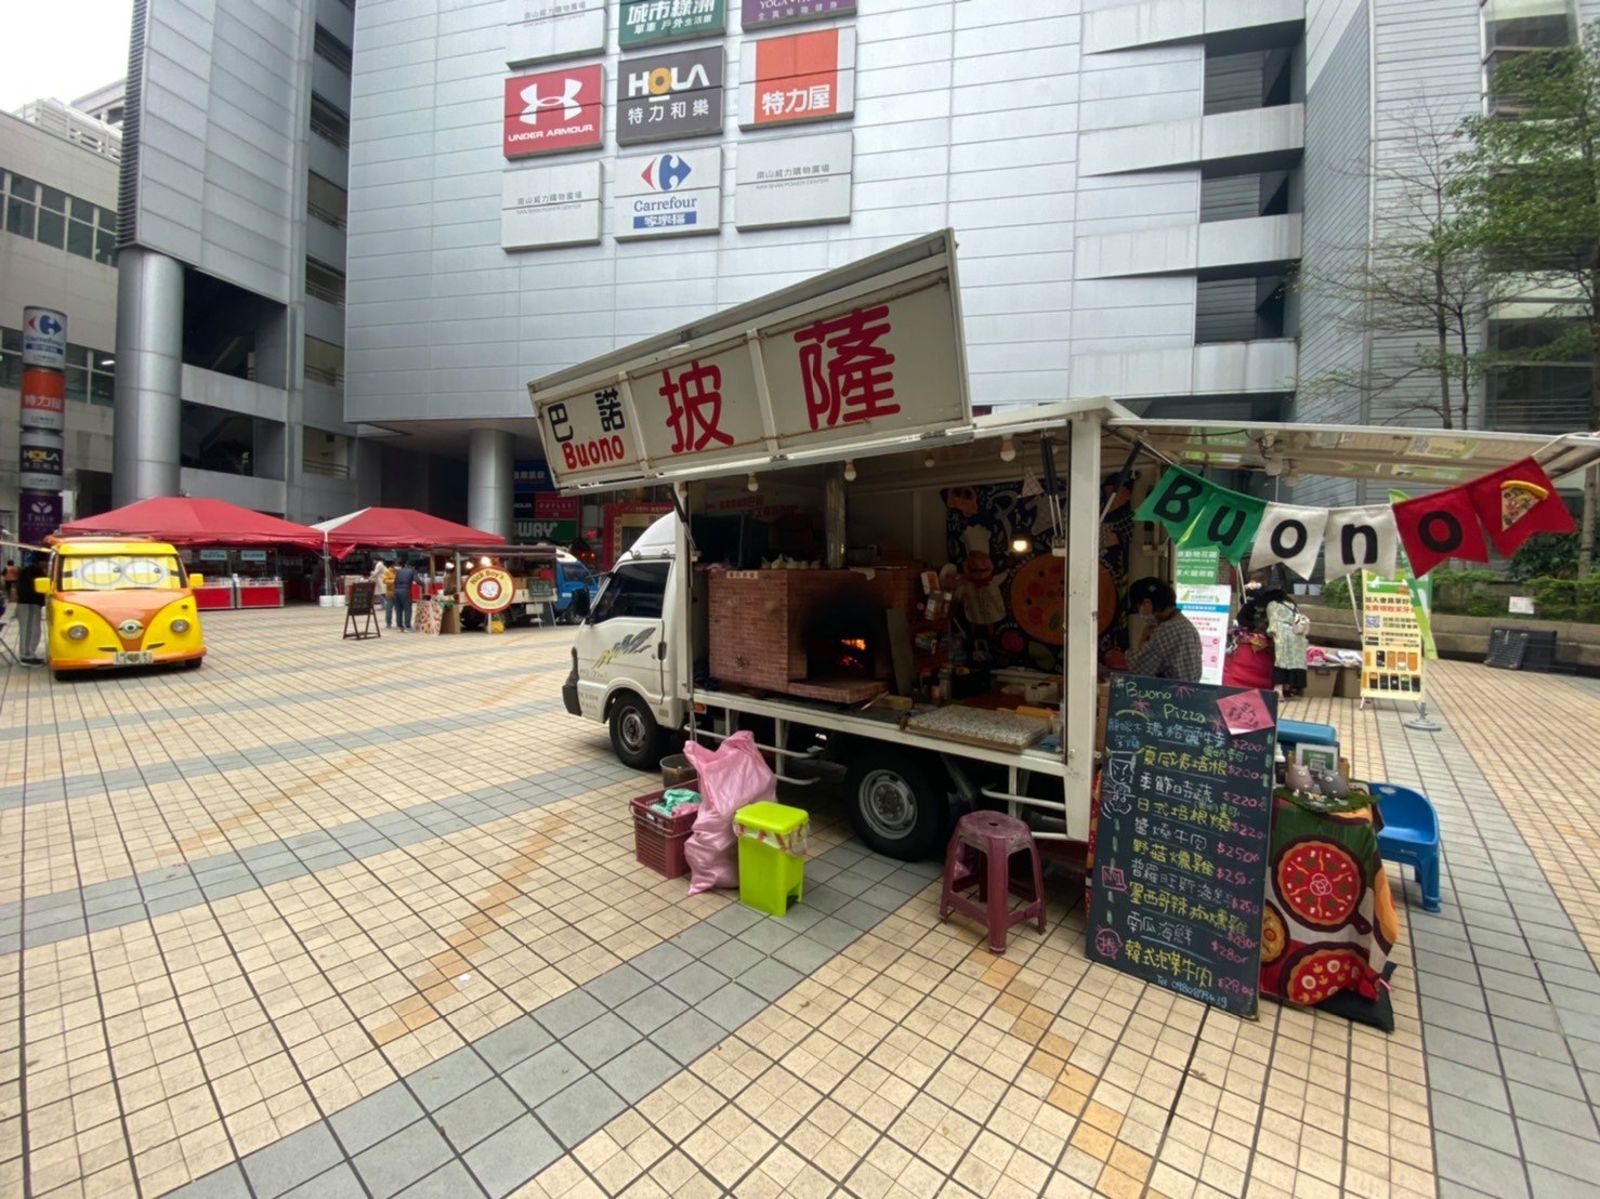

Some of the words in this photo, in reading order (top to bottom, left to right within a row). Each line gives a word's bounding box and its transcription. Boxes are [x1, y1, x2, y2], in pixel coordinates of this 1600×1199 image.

[628, 64, 710, 97] HOLA
[761, 84, 831, 116] 特力屋
[627, 99, 710, 126] 特力和樂
[508, 131, 543, 142] UNDER
[546, 124, 593, 137] ARMOUR
[633, 196, 697, 213] Carrefour
[659, 305, 901, 454] 披薩
[23, 450, 60, 462] HOLA
[561, 434, 626, 471] Buono
[1125, 682, 1172, 700] Buono
[1163, 703, 1206, 724] Pizza
